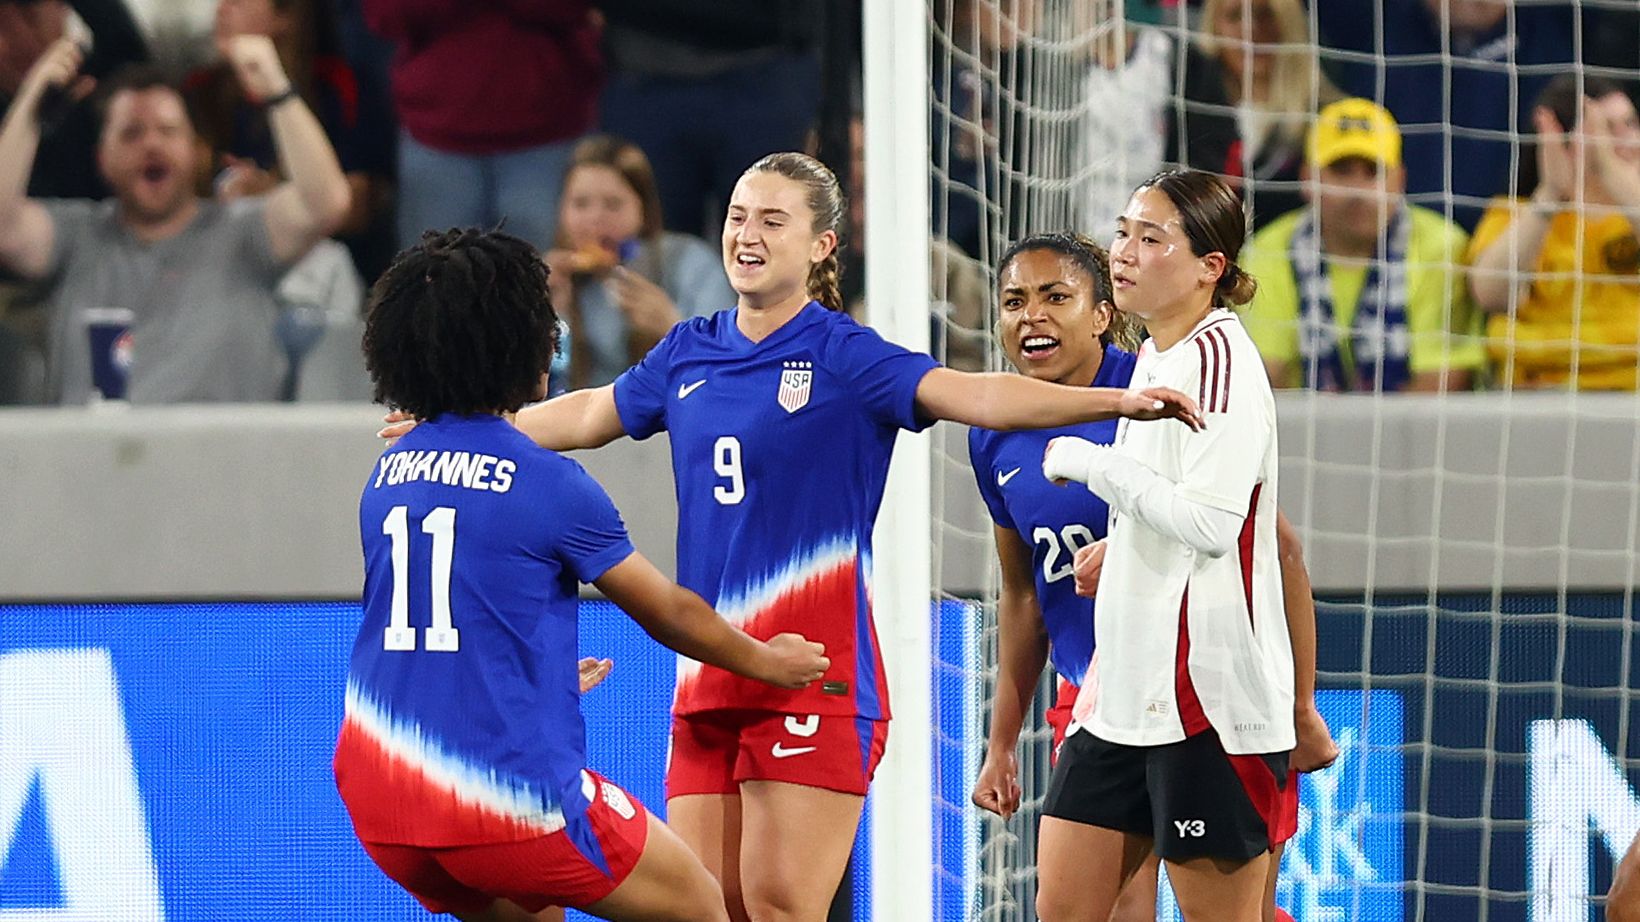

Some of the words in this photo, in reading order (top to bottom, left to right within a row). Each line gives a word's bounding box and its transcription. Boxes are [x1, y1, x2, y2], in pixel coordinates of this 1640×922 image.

[784, 372, 809, 388] USA
[374, 450, 516, 493] YOHANNES
[714, 436, 745, 504] 9
[383, 505, 459, 652] 11
[1173, 819, 1206, 838] Y-3
